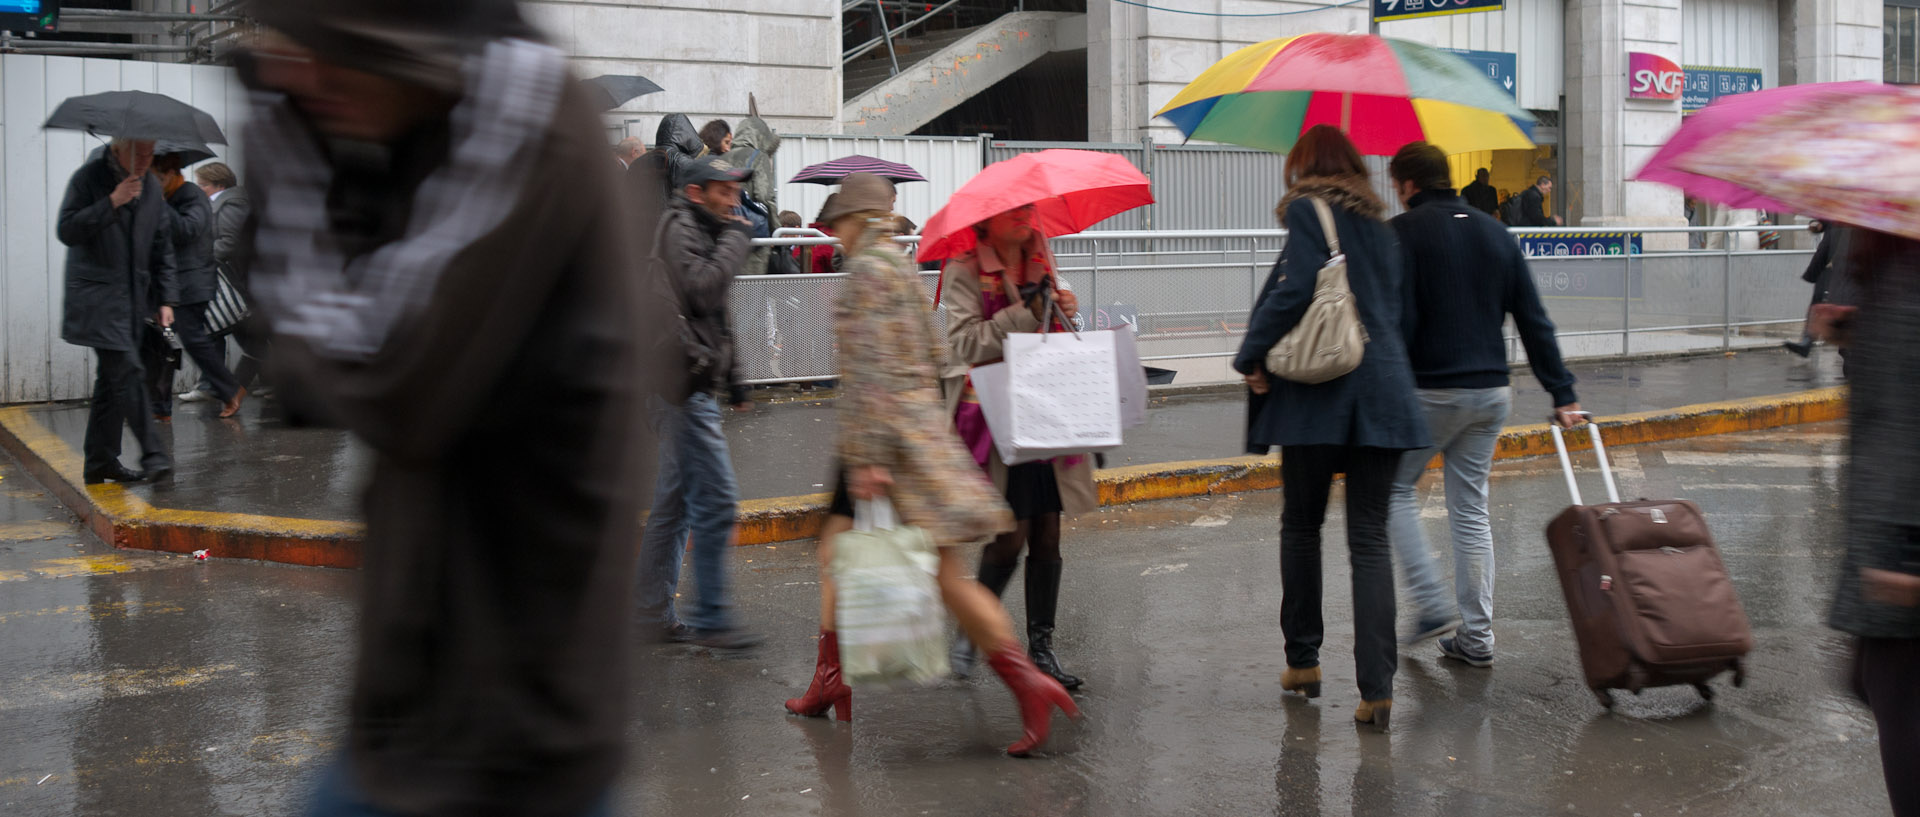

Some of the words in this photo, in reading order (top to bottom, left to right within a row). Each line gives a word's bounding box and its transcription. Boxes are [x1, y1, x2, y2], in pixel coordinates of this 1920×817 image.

[1633, 69, 1683, 94] SNCF
[1700, 81, 1708, 90] 12
[1721, 82, 1729, 91] 13
[1608, 247, 1620, 256] 12
